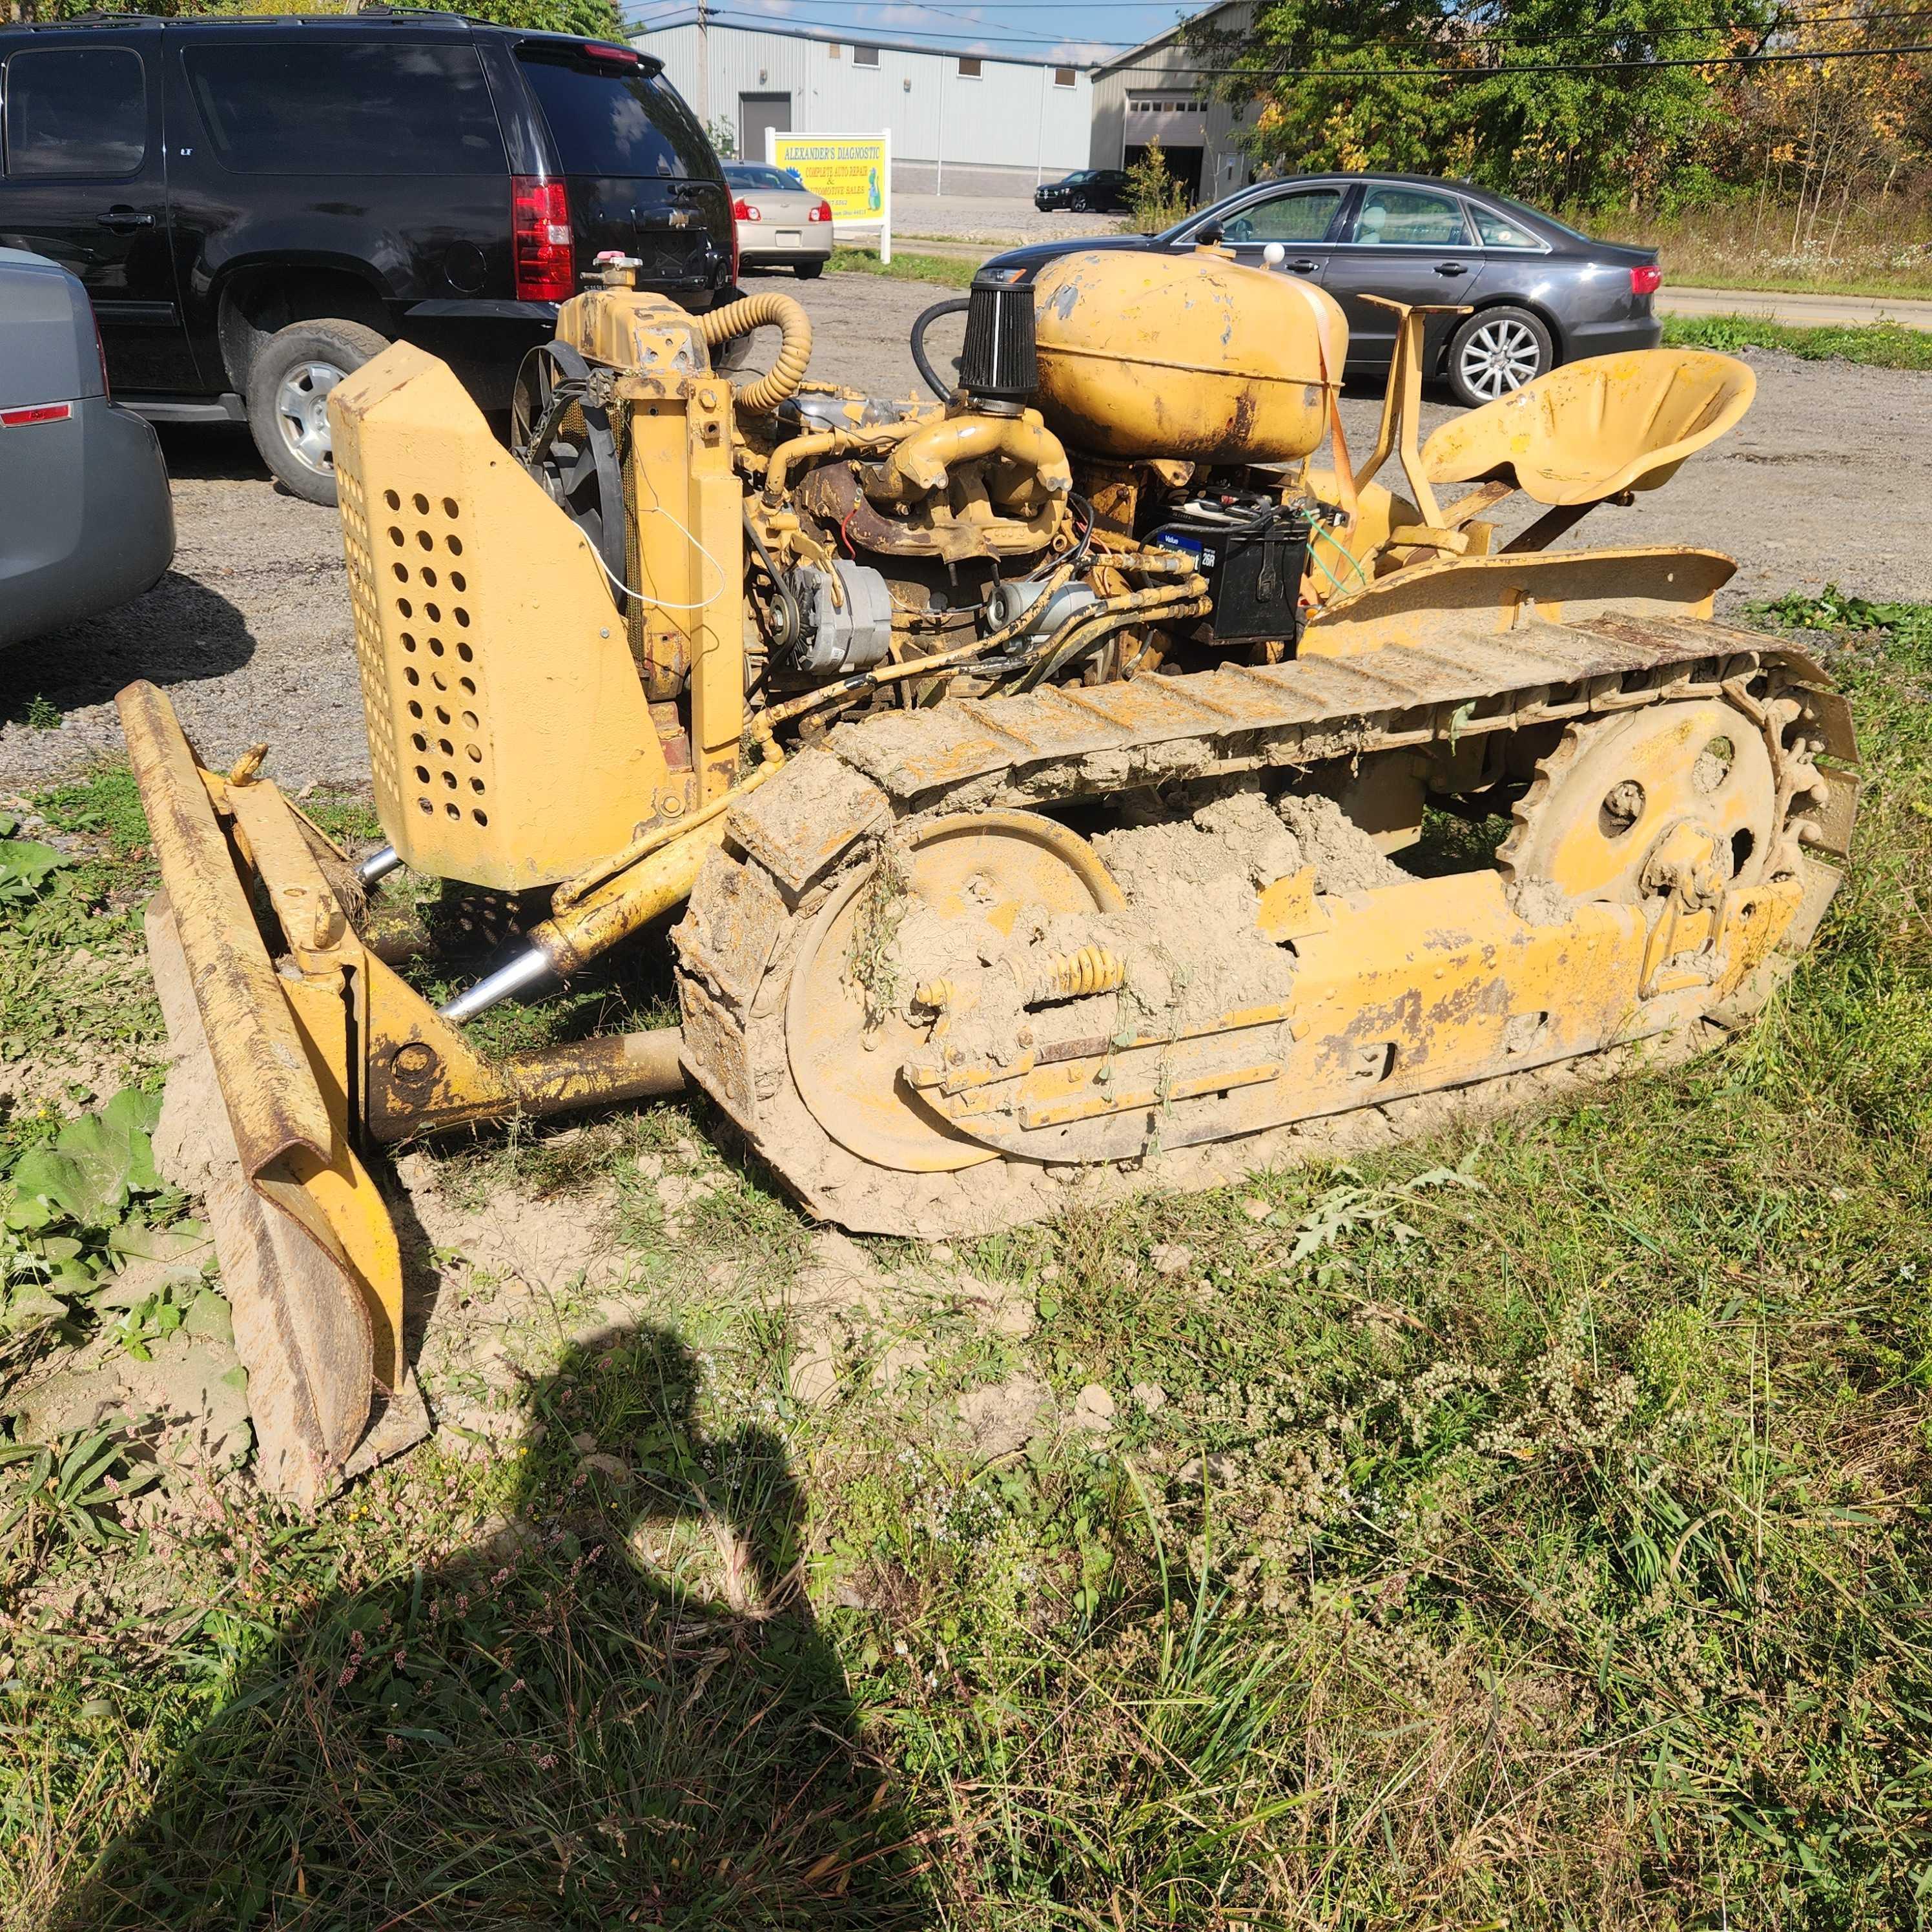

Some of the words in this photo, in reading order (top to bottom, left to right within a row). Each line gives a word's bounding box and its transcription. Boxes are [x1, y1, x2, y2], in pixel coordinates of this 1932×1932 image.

[785, 147, 836, 161] ALEXANDER'S
[838, 146, 880, 160] DIAGNOSTIC
[805, 167, 832, 178] COMPLETE
[834, 166, 849, 177] AUTO
[849, 165, 868, 176] REPAIR
[845, 185, 865, 194] SALES
[1165, 535, 1179, 545] Value
[1202, 552, 1215, 568] 26R
